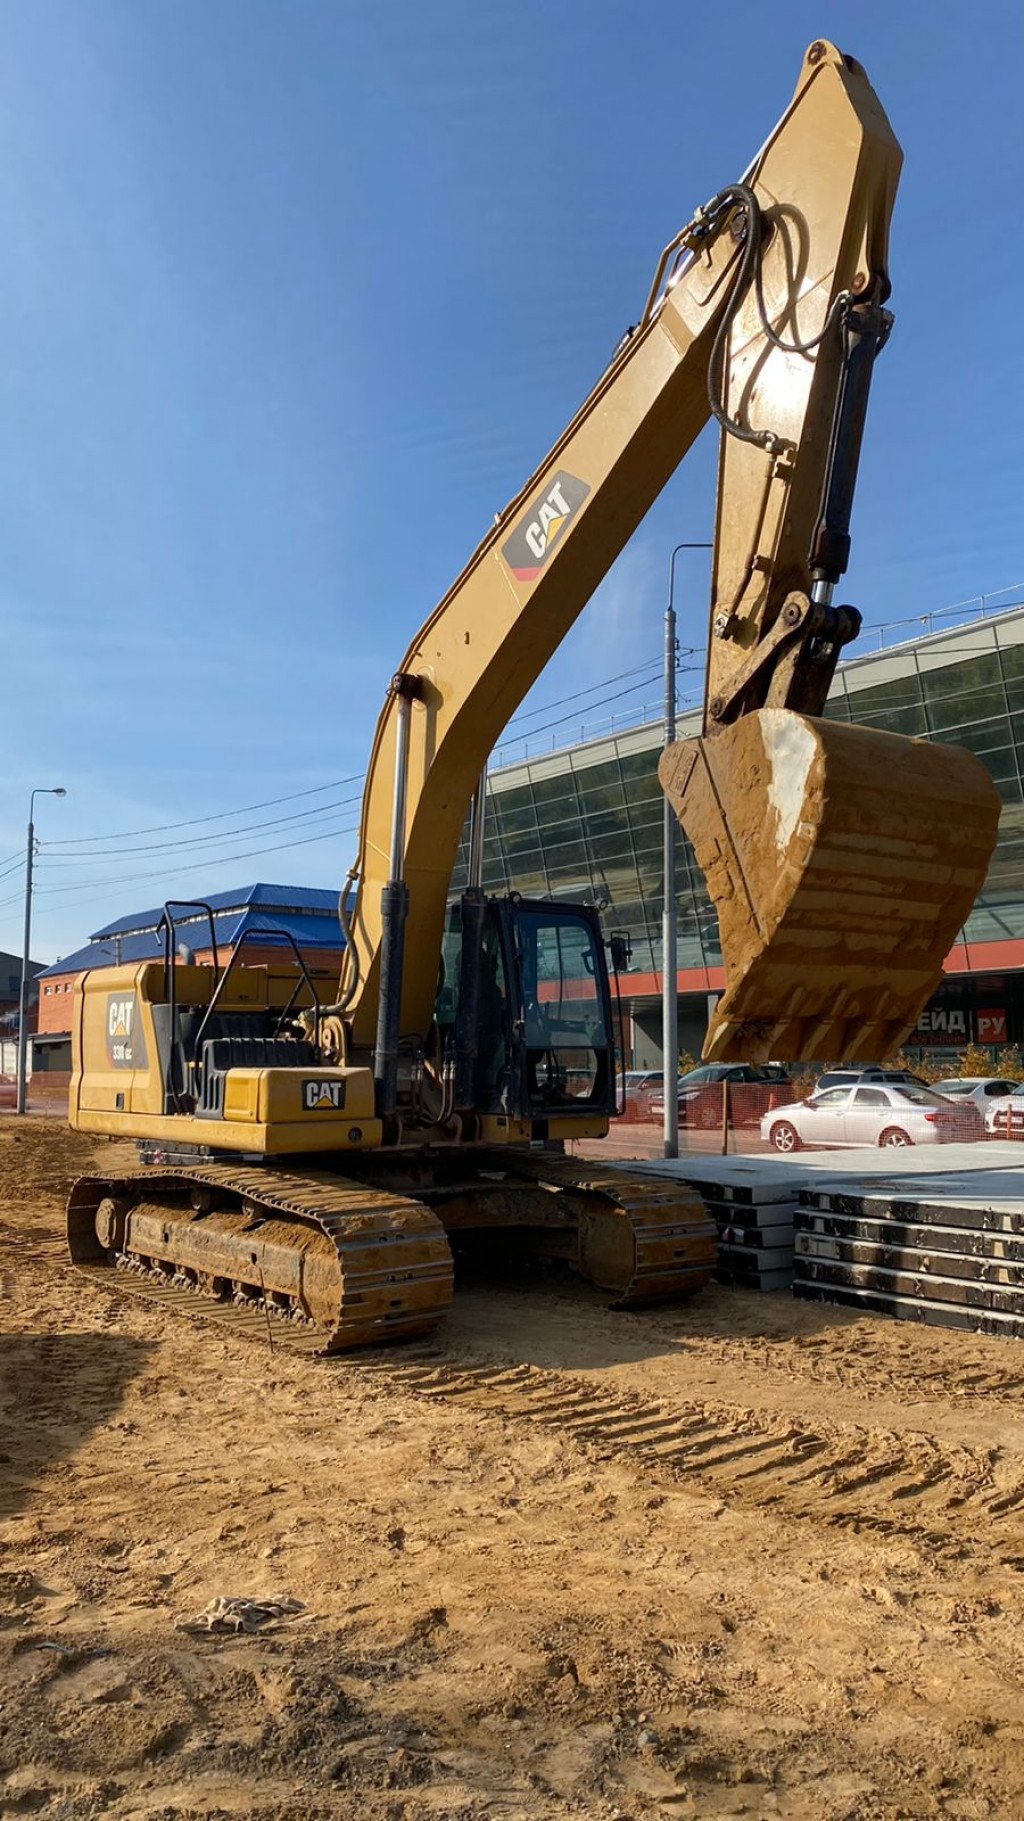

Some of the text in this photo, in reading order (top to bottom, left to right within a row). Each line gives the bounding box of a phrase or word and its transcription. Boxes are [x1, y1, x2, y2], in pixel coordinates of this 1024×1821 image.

[525, 481, 571, 559] CAT
[109, 1002, 133, 1036] CAT
[917, 1007, 1005, 1036] ЕЙД РУ
[306, 1082, 341, 1107] CAT
